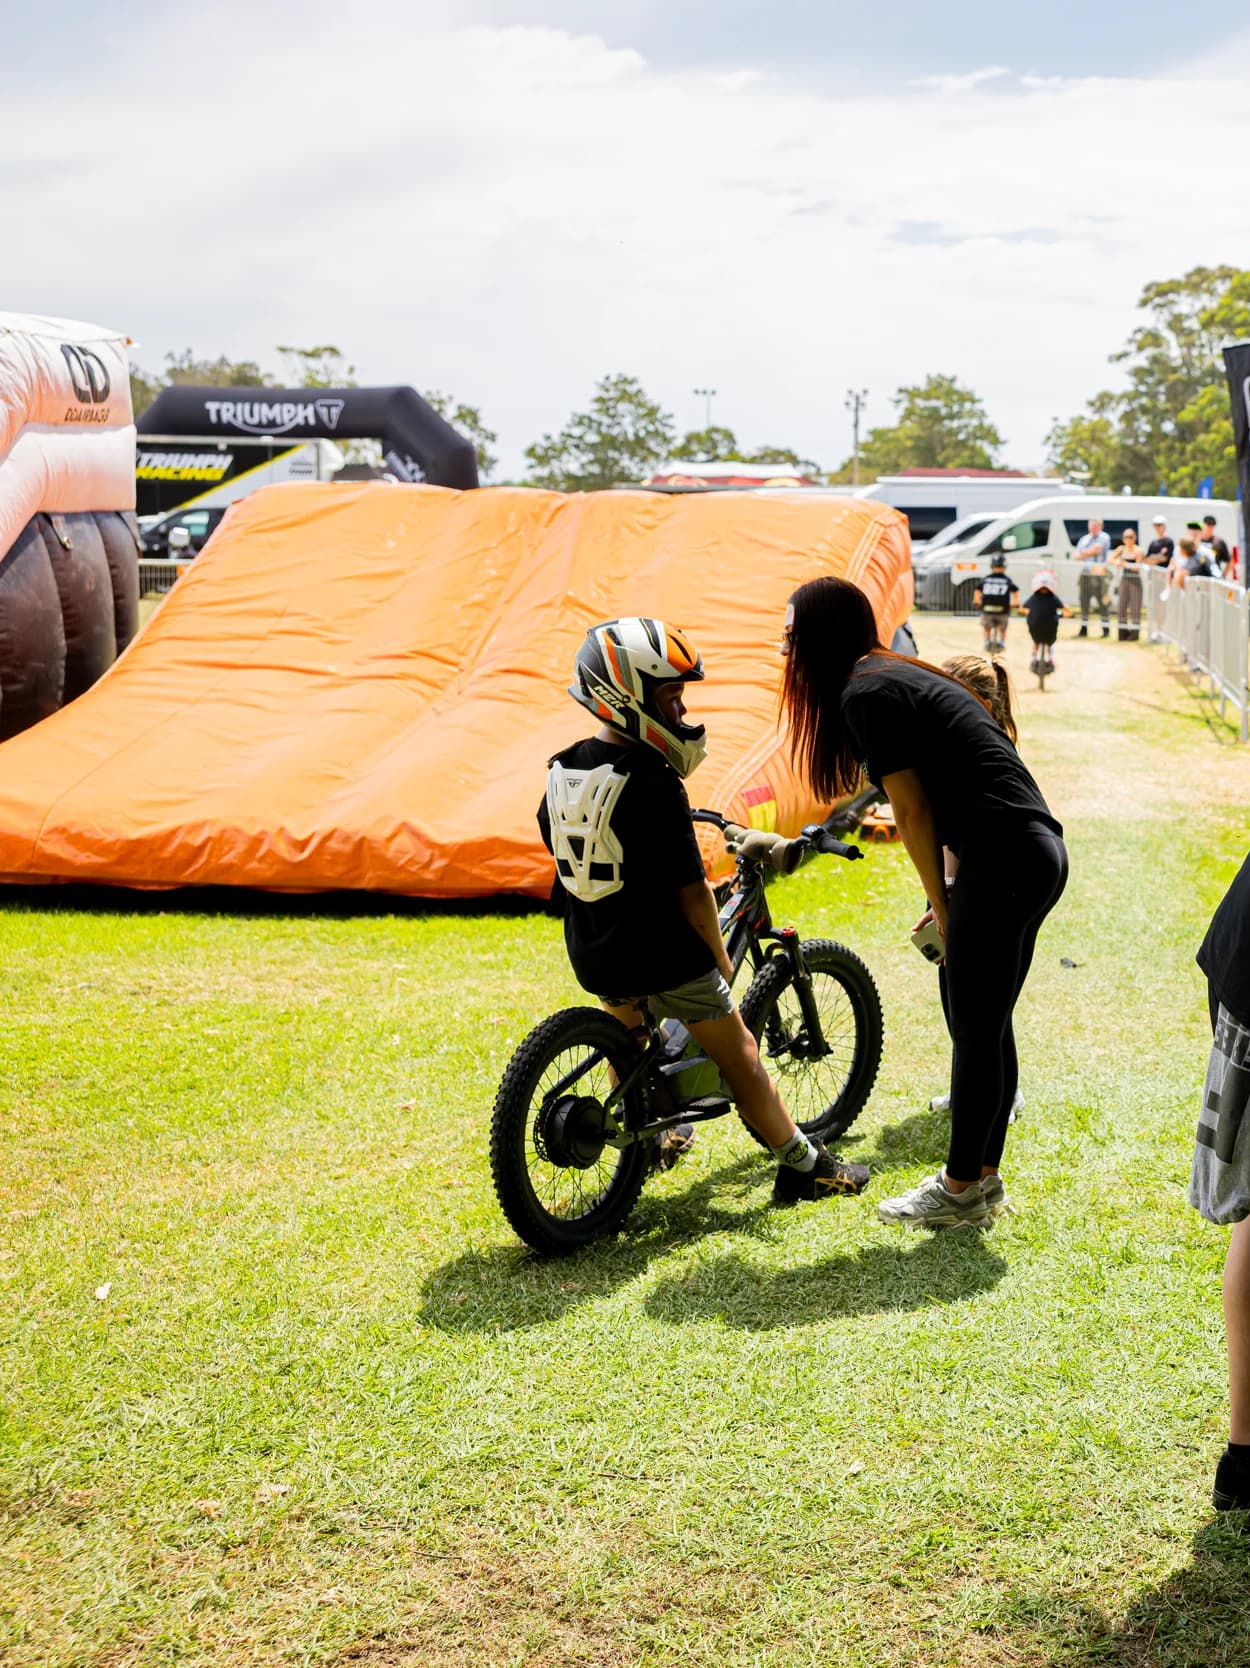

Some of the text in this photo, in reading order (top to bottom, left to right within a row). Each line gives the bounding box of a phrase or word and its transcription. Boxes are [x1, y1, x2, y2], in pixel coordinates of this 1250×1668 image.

[205, 401, 316, 434] TRIUMPH
[138, 452, 234, 469] TRIUMPH
[136, 467, 226, 481] RACING
